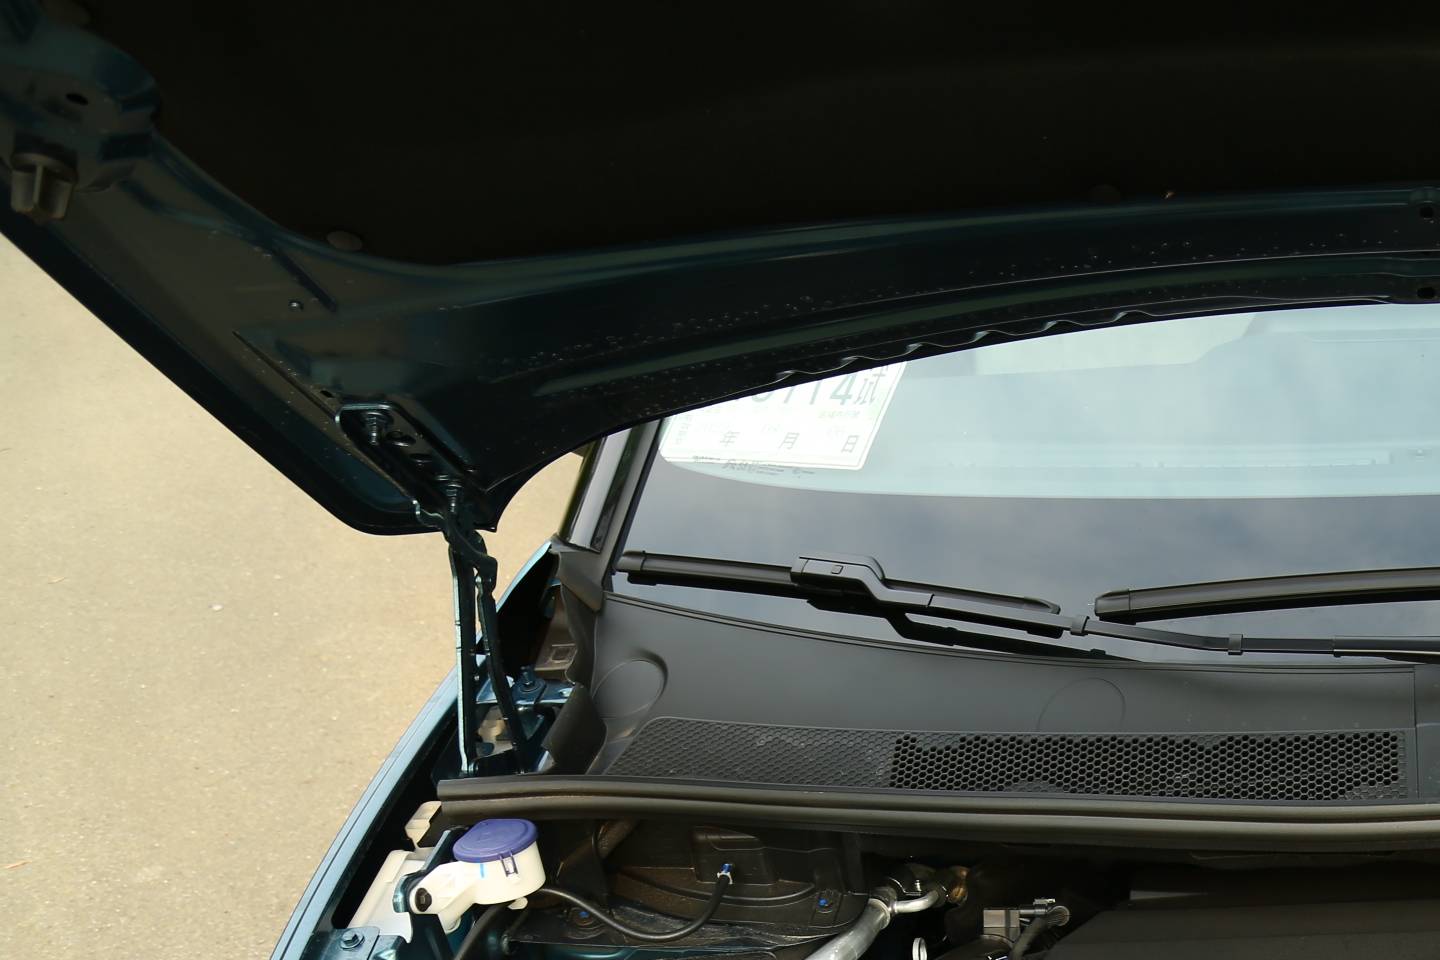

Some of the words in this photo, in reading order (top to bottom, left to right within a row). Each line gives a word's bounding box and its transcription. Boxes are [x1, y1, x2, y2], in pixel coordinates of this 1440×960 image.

[719, 430, 740, 447] 年
[778, 432, 799, 450] 月
[841, 434, 860, 453] 日
